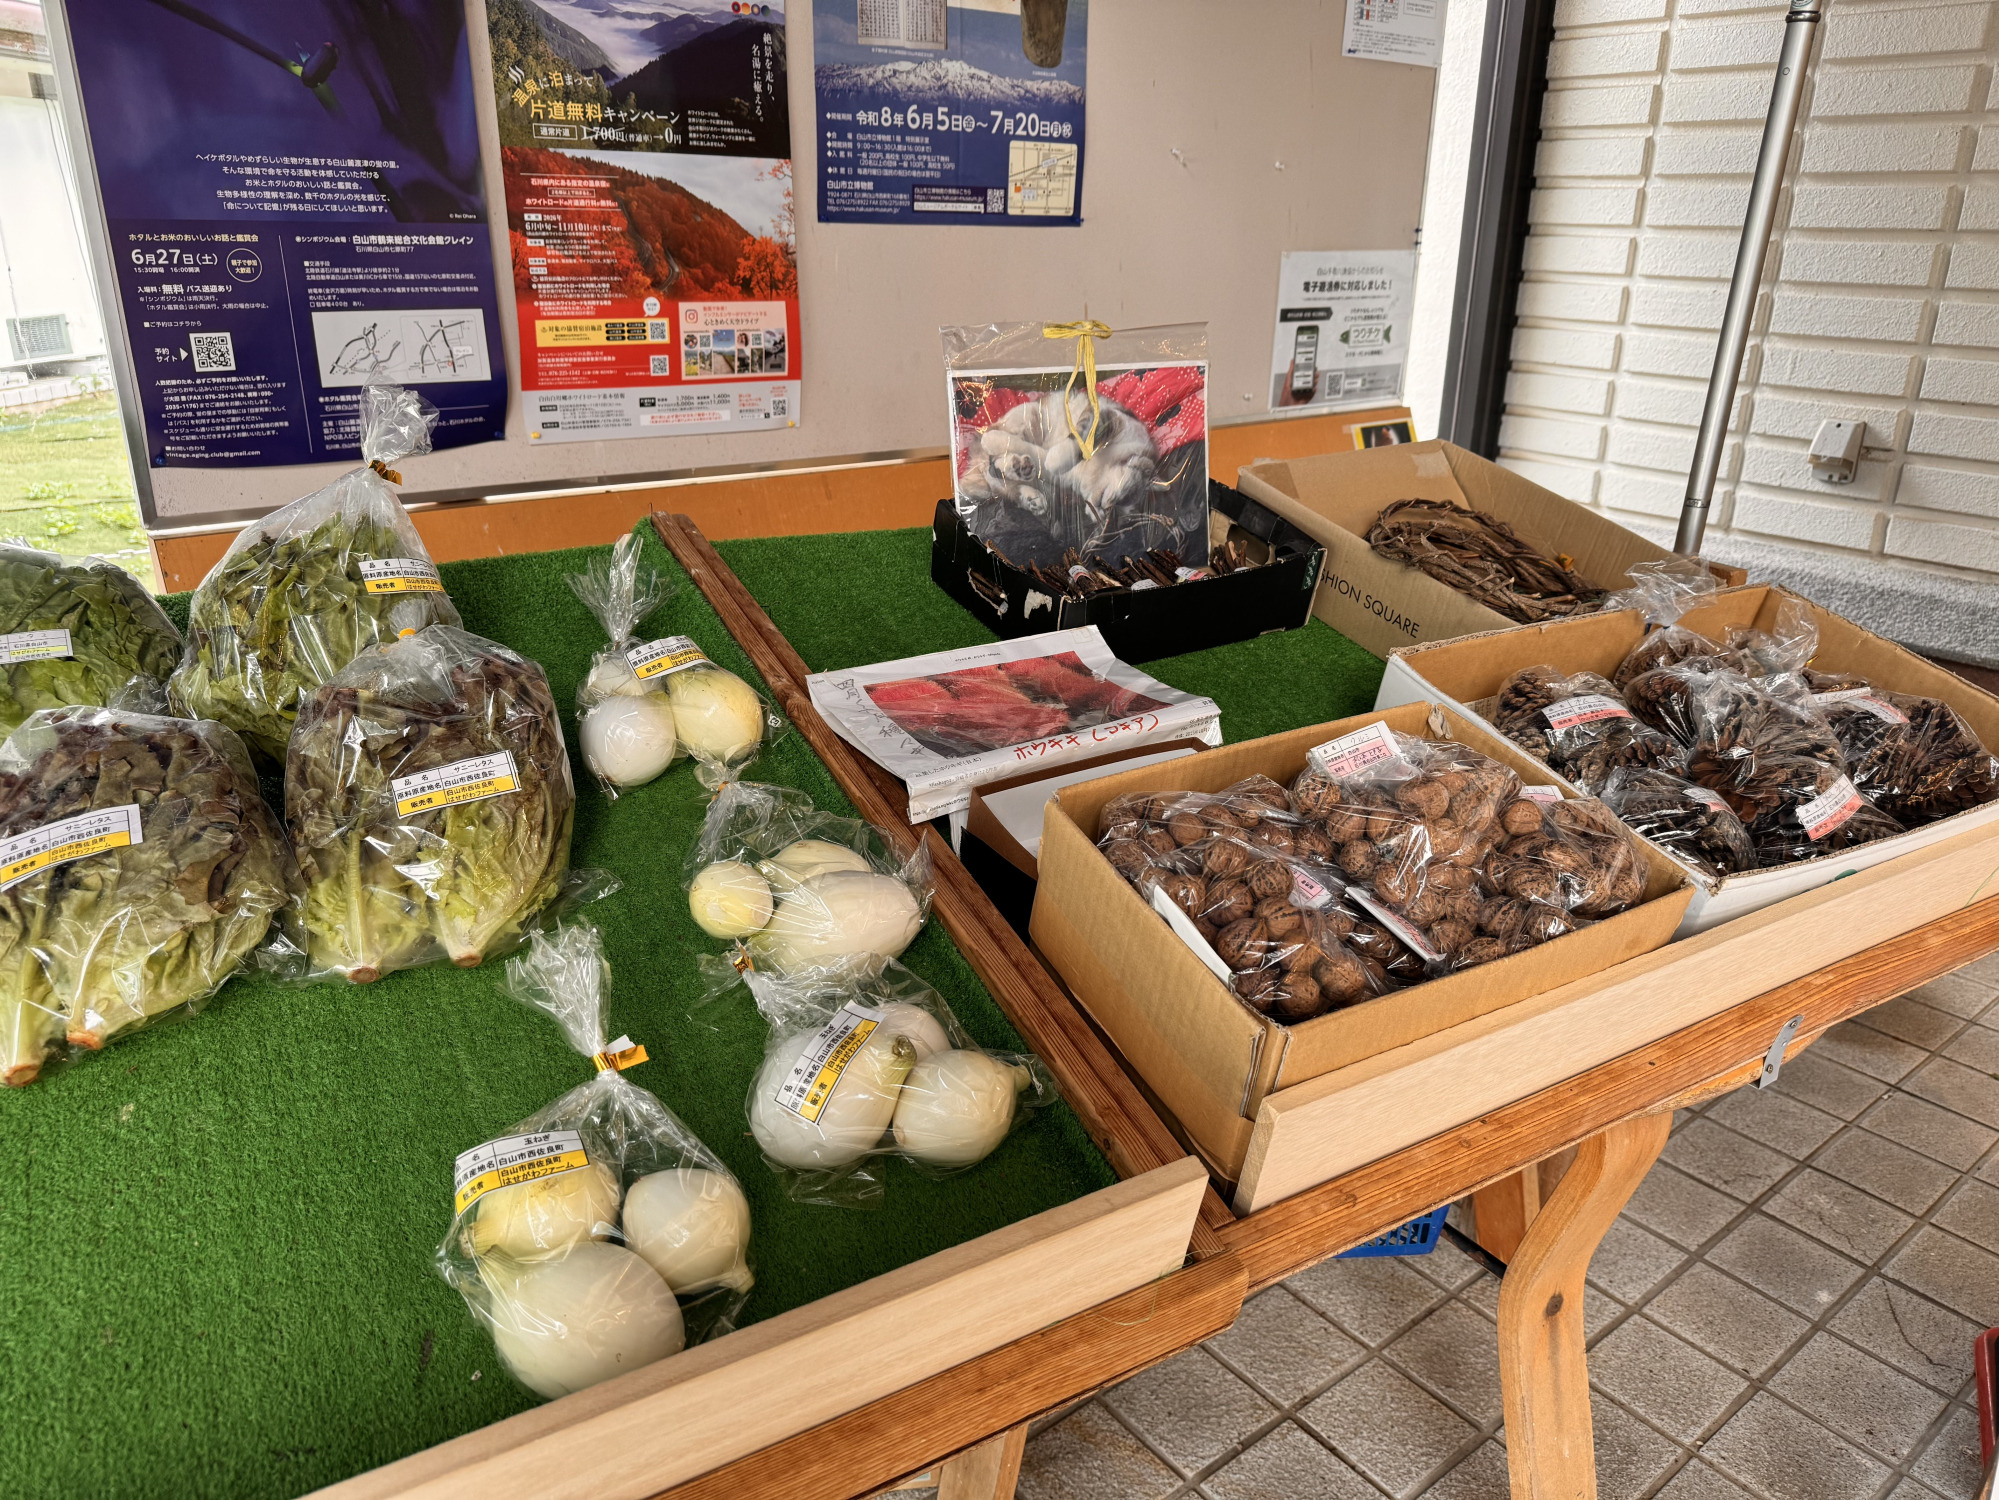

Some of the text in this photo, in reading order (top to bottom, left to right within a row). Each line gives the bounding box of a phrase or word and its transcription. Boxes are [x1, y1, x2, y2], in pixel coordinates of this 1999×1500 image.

[763, 32, 775, 101] 絶景を走り、
[511, 71, 594, 107] 温泉に泊まって
[531, 100, 680, 124] 片道無料キャンペーン
[540, 127, 570, 137] 通常片道
[128, 233, 259, 242] ホタルとお米のおいしいお話と鑑賞会
[154, 347, 170, 355] 予約
[156, 354, 178, 362] サイト
[363, 570, 402, 579] 原料原産地名
[1363, 594, 1420, 638] SQUARE
[454, 759, 494, 773] サニーレタス
[397, 770, 496, 799] 原料原産地名 白山市西佐良町
[410, 781, 494, 808] 販売者 白山市西佐良町
[448, 787, 499, 802] はせがわファーム
[65, 816, 112, 831] サニーレタス
[52, 826, 111, 847] 白山市西佐良町
[13, 837, 106, 874] 販売者 白山市西佐良町
[52, 843, 111, 861] はせがわファーム
[817, 1024, 853, 1062] 白山市西佐良町
[834, 1029, 871, 1072] はせがわファーム
[784, 1024, 836, 1093] 品 名 玉ねぎ
[472, 1134, 550, 1161] 名 玉ねぎ
[499, 1144, 564, 1165] 白山市西佐良町
[501, 1156, 562, 1177] 白山市西佐良町
[502, 1162, 574, 1185] はせがわファーム
